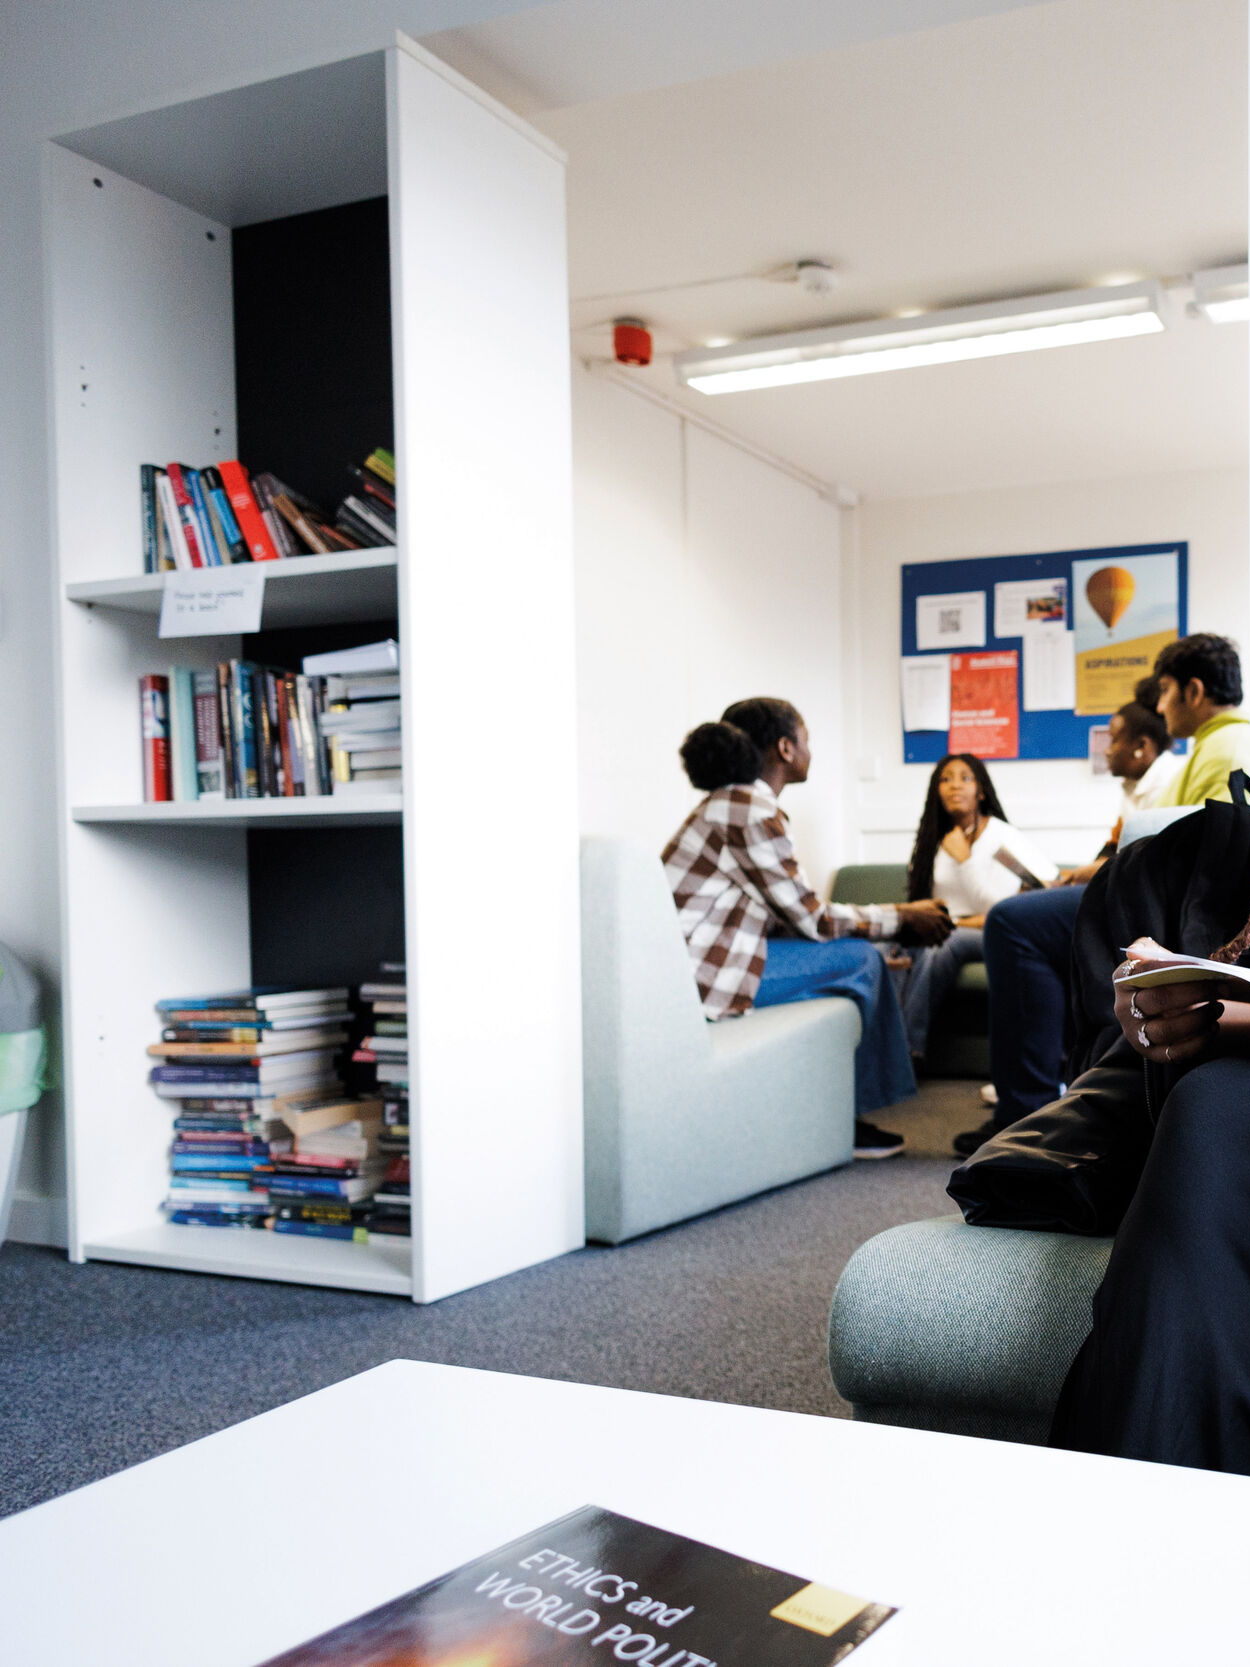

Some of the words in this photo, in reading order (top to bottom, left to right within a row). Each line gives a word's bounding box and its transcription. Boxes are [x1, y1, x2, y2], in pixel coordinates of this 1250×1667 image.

[475, 1571, 601, 1636] WORLD
[591, 1623, 718, 1667] POLIT
[518, 1548, 639, 1604] ETHICS
[625, 1595, 695, 1628] and
